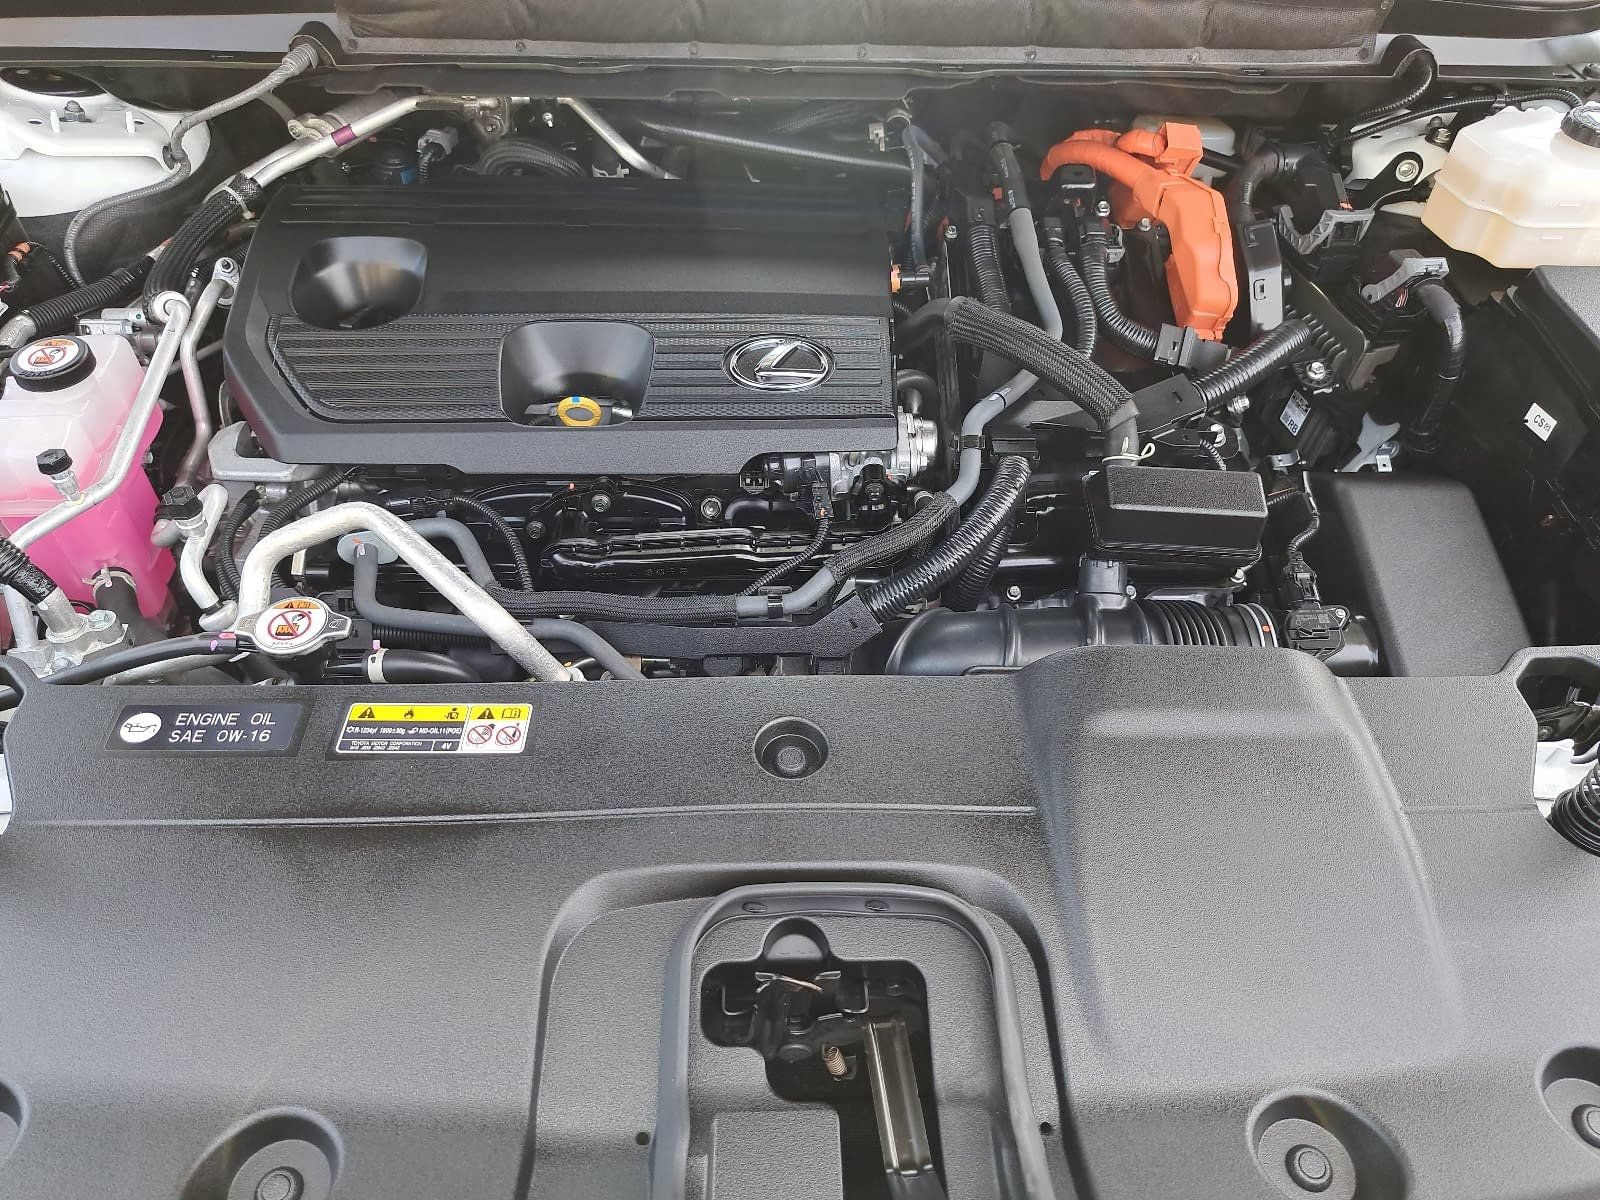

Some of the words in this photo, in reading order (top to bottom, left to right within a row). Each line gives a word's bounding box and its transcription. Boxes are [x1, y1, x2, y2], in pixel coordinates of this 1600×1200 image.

[175, 713, 240, 726] ENGINE
[250, 713, 276, 726] OIL
[168, 730, 206, 743] SAE
[216, 730, 271, 743] 0W-16
[441, 742, 452, 750] 4V
